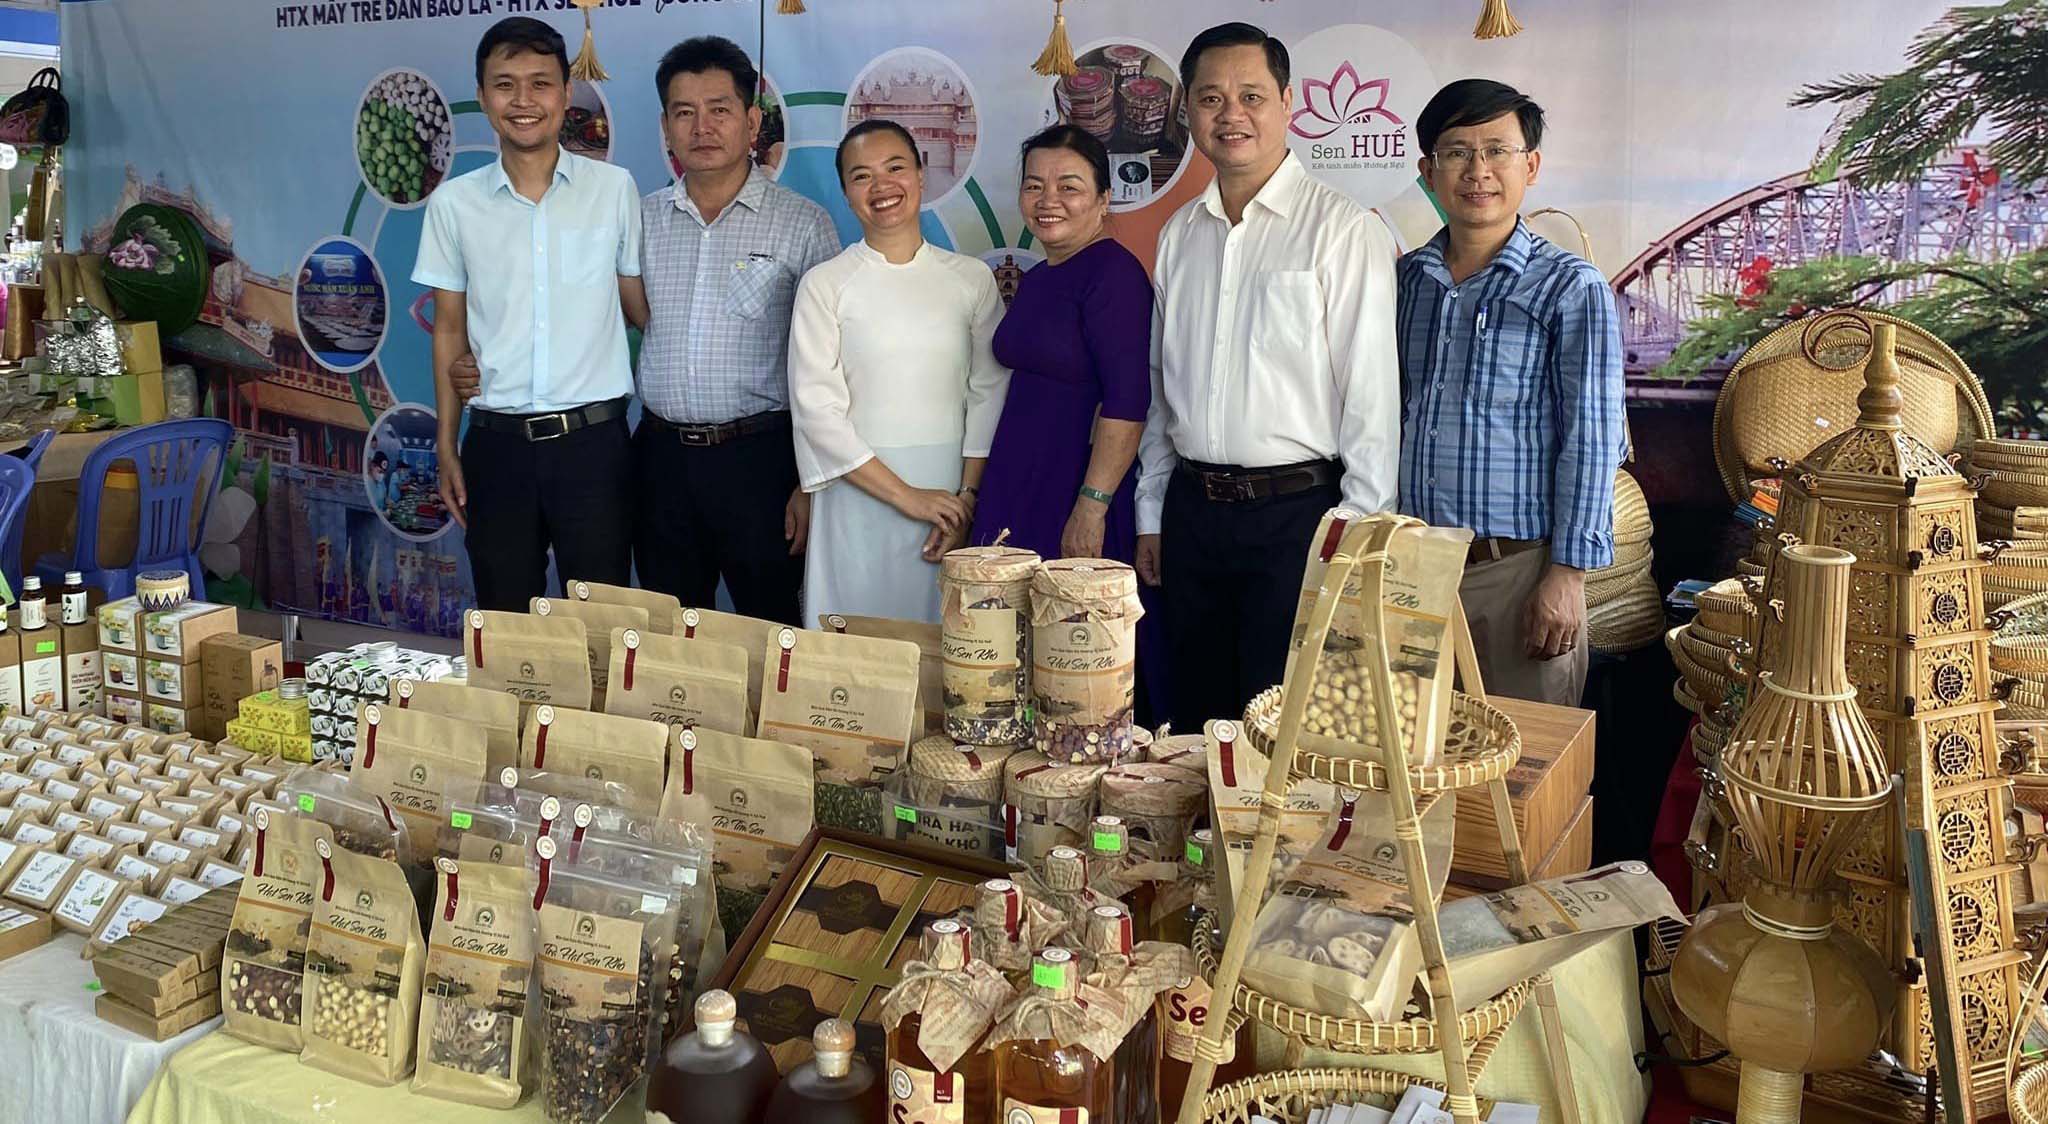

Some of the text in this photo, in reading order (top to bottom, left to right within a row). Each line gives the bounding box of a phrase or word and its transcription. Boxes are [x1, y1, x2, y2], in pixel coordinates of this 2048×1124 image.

[276, 7, 309, 28] HTX
[351, 2, 383, 23] TRE
[1311, 126, 1406, 159] Sen HUẾ
[957, 646, 973, 660] Sen
[1071, 658, 1090, 671] Sen
[846, 719, 864, 733] Sen
[748, 822, 765, 836] Sen
[278, 887, 294, 902] Sen
[350, 920, 366, 935] Sen
[467, 938, 485, 953] Sen
[583, 951, 601, 967] Sen
